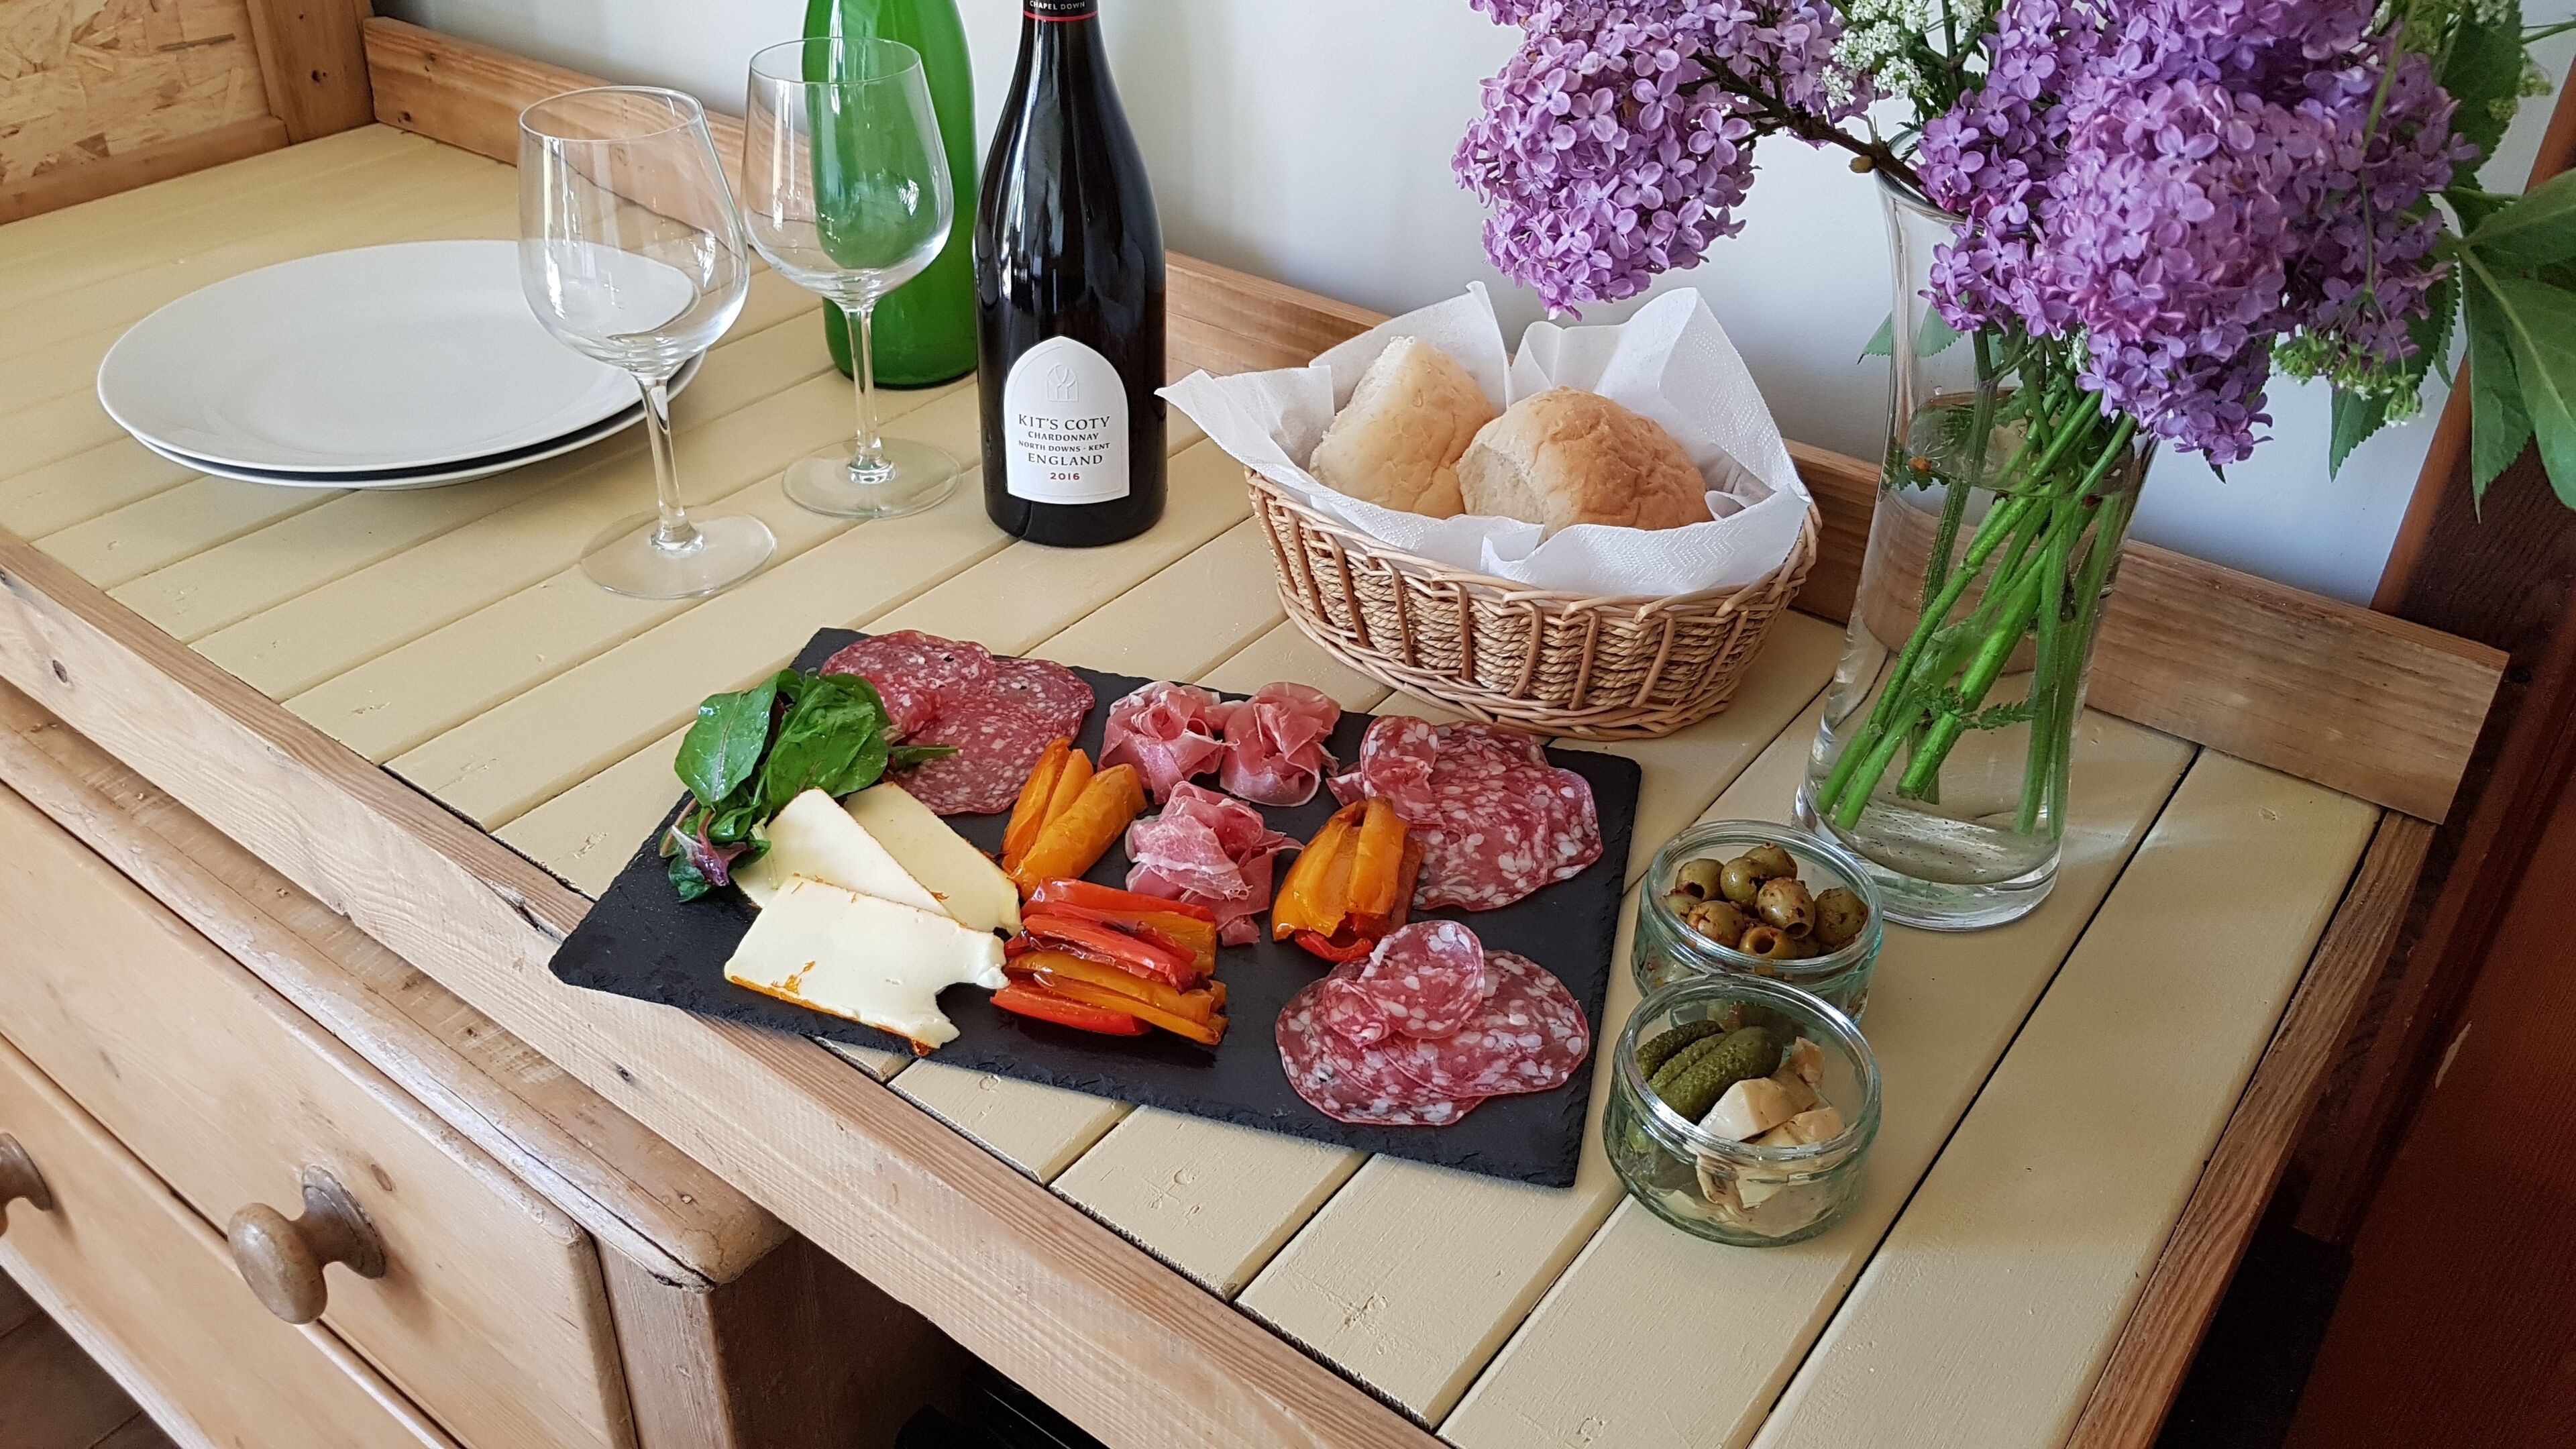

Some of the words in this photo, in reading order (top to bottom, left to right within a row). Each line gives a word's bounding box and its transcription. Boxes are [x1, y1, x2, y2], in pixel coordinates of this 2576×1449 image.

[1030, 1, 1057, 10] CHAPEL
[1061, 2, 1085, 10] DOWN
[1018, 414, 1058, 430] KIT'S
[1065, 416, 1110, 430] COTY
[1028, 431, 1099, 441] CHARDONNAY
[1018, 440, 1045, 450] NORTH
[1088, 442, 1110, 451] KENT
[1028, 453, 1102, 466] ENGLAND
[1050, 472, 1080, 480] 2016
